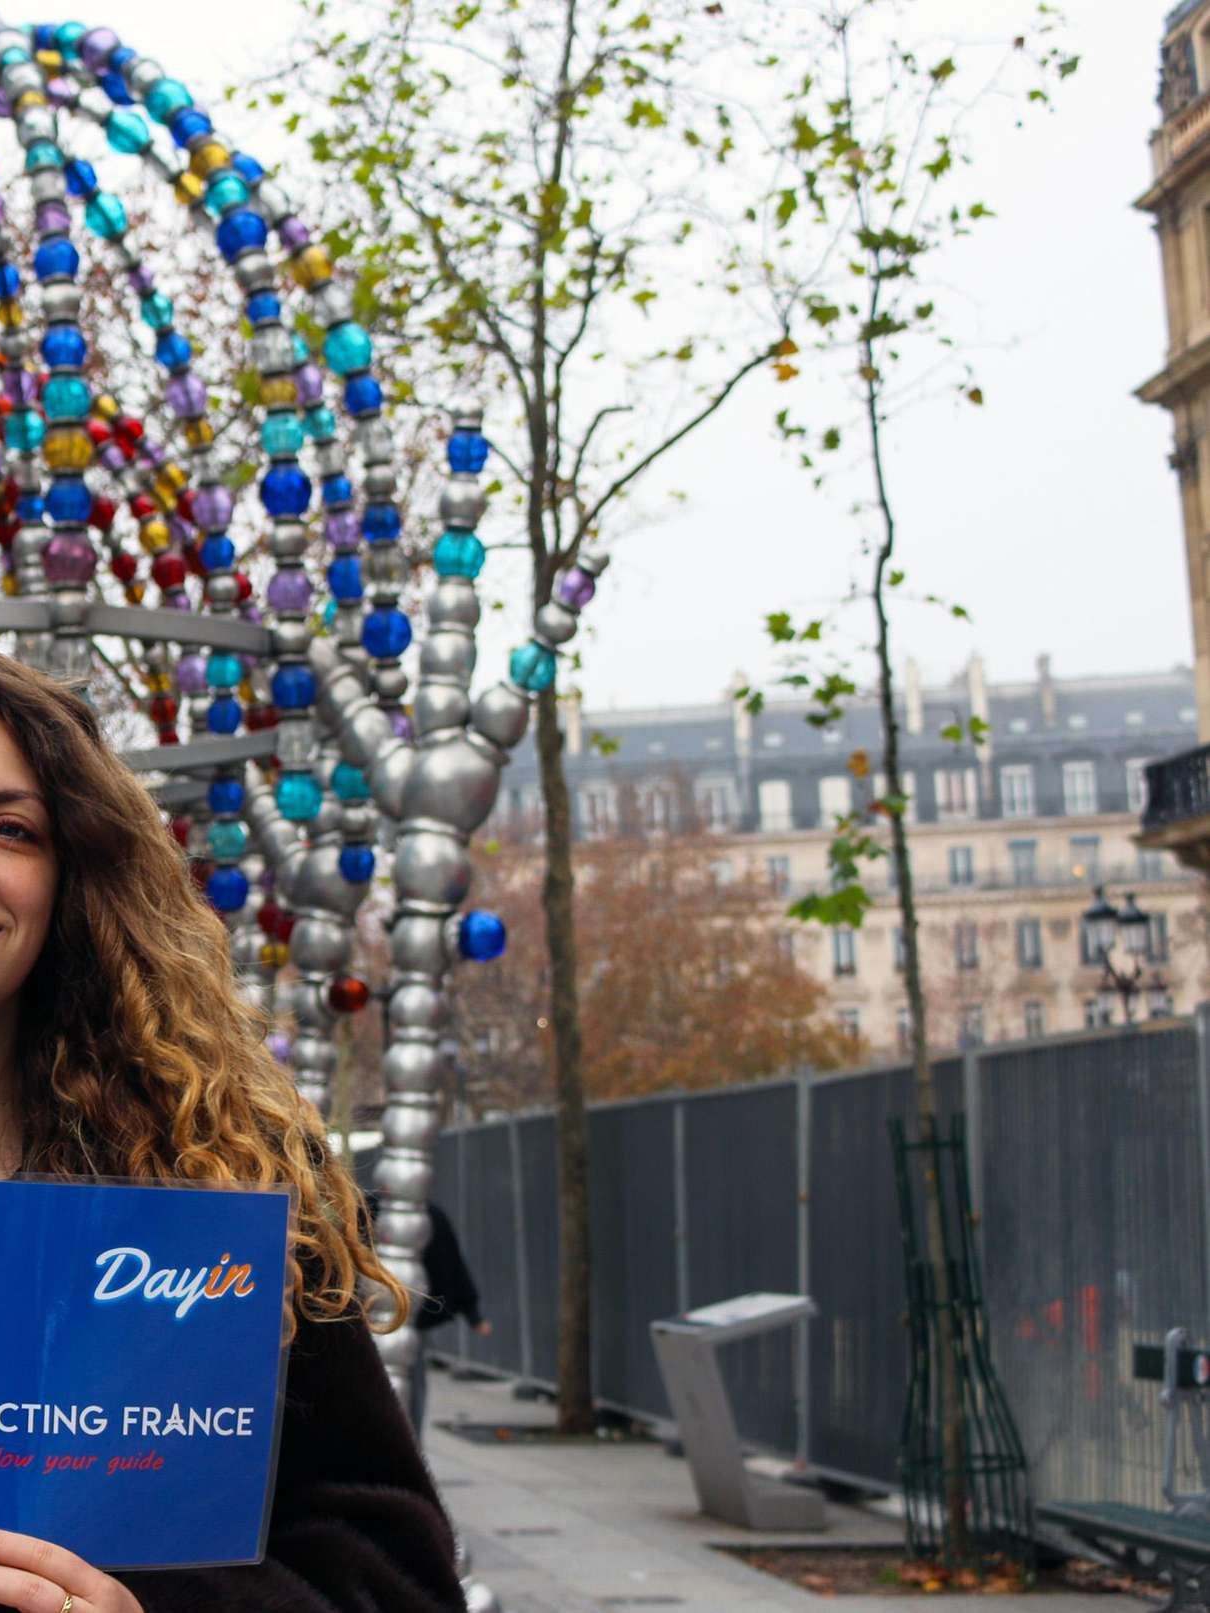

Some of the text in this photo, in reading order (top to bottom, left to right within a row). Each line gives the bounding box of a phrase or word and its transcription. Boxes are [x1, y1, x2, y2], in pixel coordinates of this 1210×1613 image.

[94, 1247, 255, 1318] Dayin
[122, 1403, 255, 1437] FRANCE
[42, 1454, 97, 1475] your
[106, 1450, 165, 1476] guide
